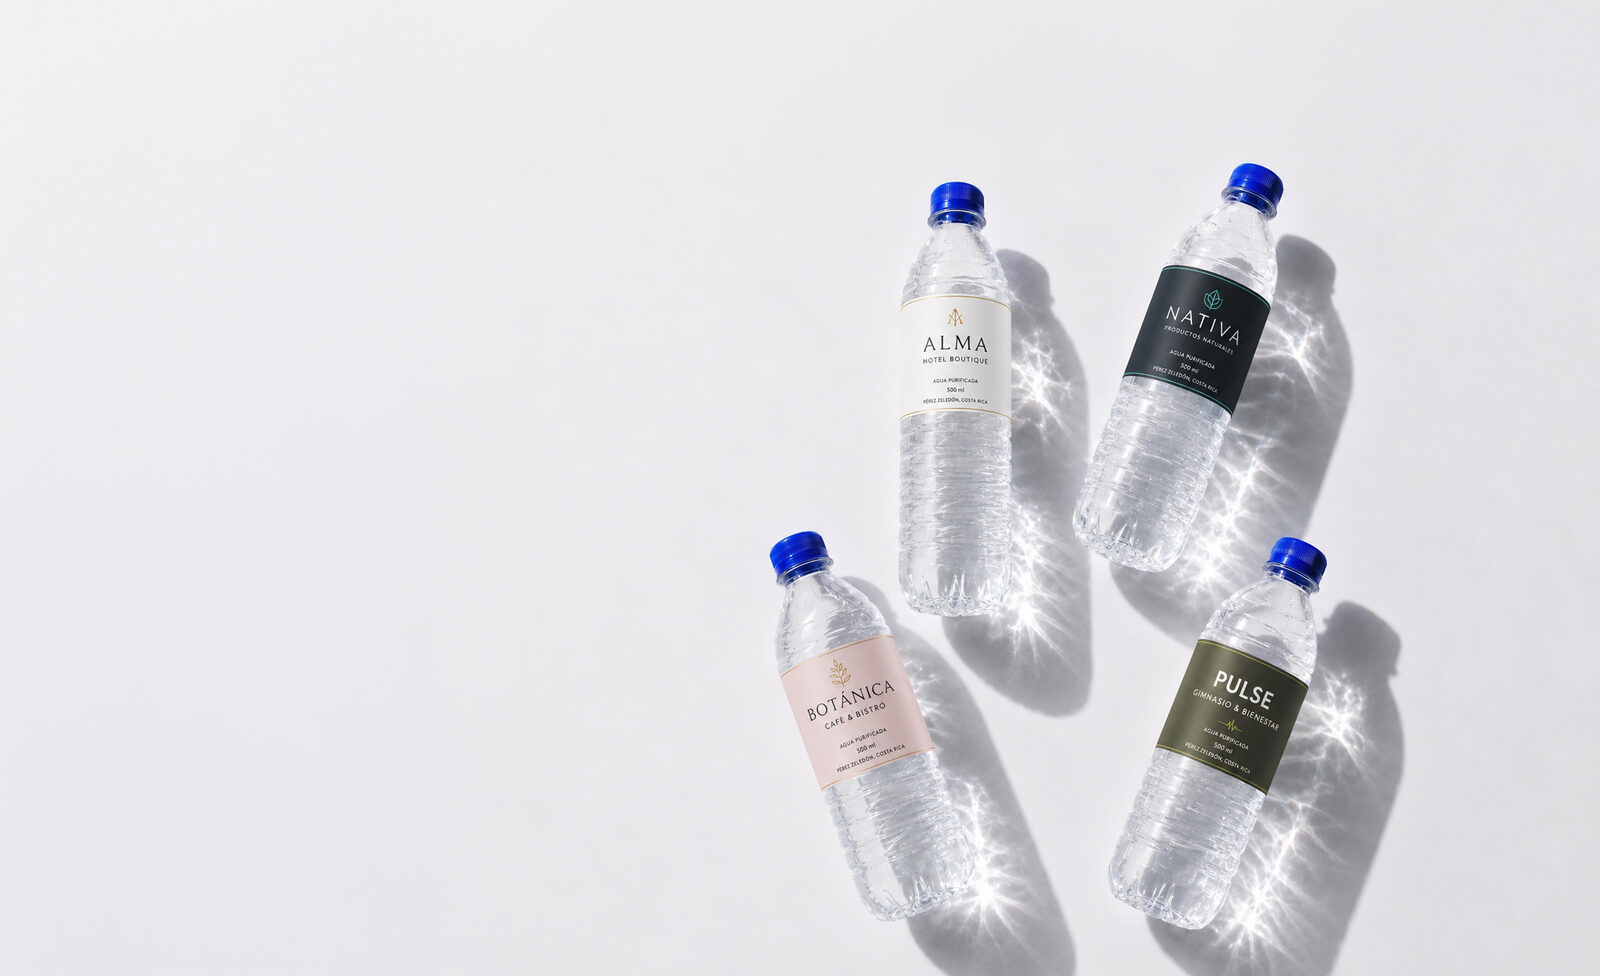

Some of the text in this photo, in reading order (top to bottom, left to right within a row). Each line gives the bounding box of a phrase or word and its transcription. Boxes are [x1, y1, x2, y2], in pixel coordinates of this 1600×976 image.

[1165, 305, 1240, 346] NATIVA
[923, 335, 988, 353] ALMA
[1164, 325, 1234, 355] PRODUCTOS NATURALES
[922, 355, 989, 365] HOTEL BOUTIQUE
[1169, 349, 1185, 358] AGUA
[1179, 362, 1191, 371] 500
[1192, 378, 1208, 388] COSTA
[1213, 669, 1275, 710] PULSE
[806, 680, 895, 721] BOTÁNICA
[824, 701, 886, 730] CAFÉ & BISTRÓ
[1192, 688, 1280, 731] GIMNASIO & BIENESTAR
[839, 727, 887, 749] AGUA PURIFICADA
[1203, 726, 1218, 737] AGUA
[856, 745, 867, 754] 500
[876, 748, 893, 758] COSTA
[893, 744, 906, 753] RICA
[1213, 742, 1225, 751] 500
